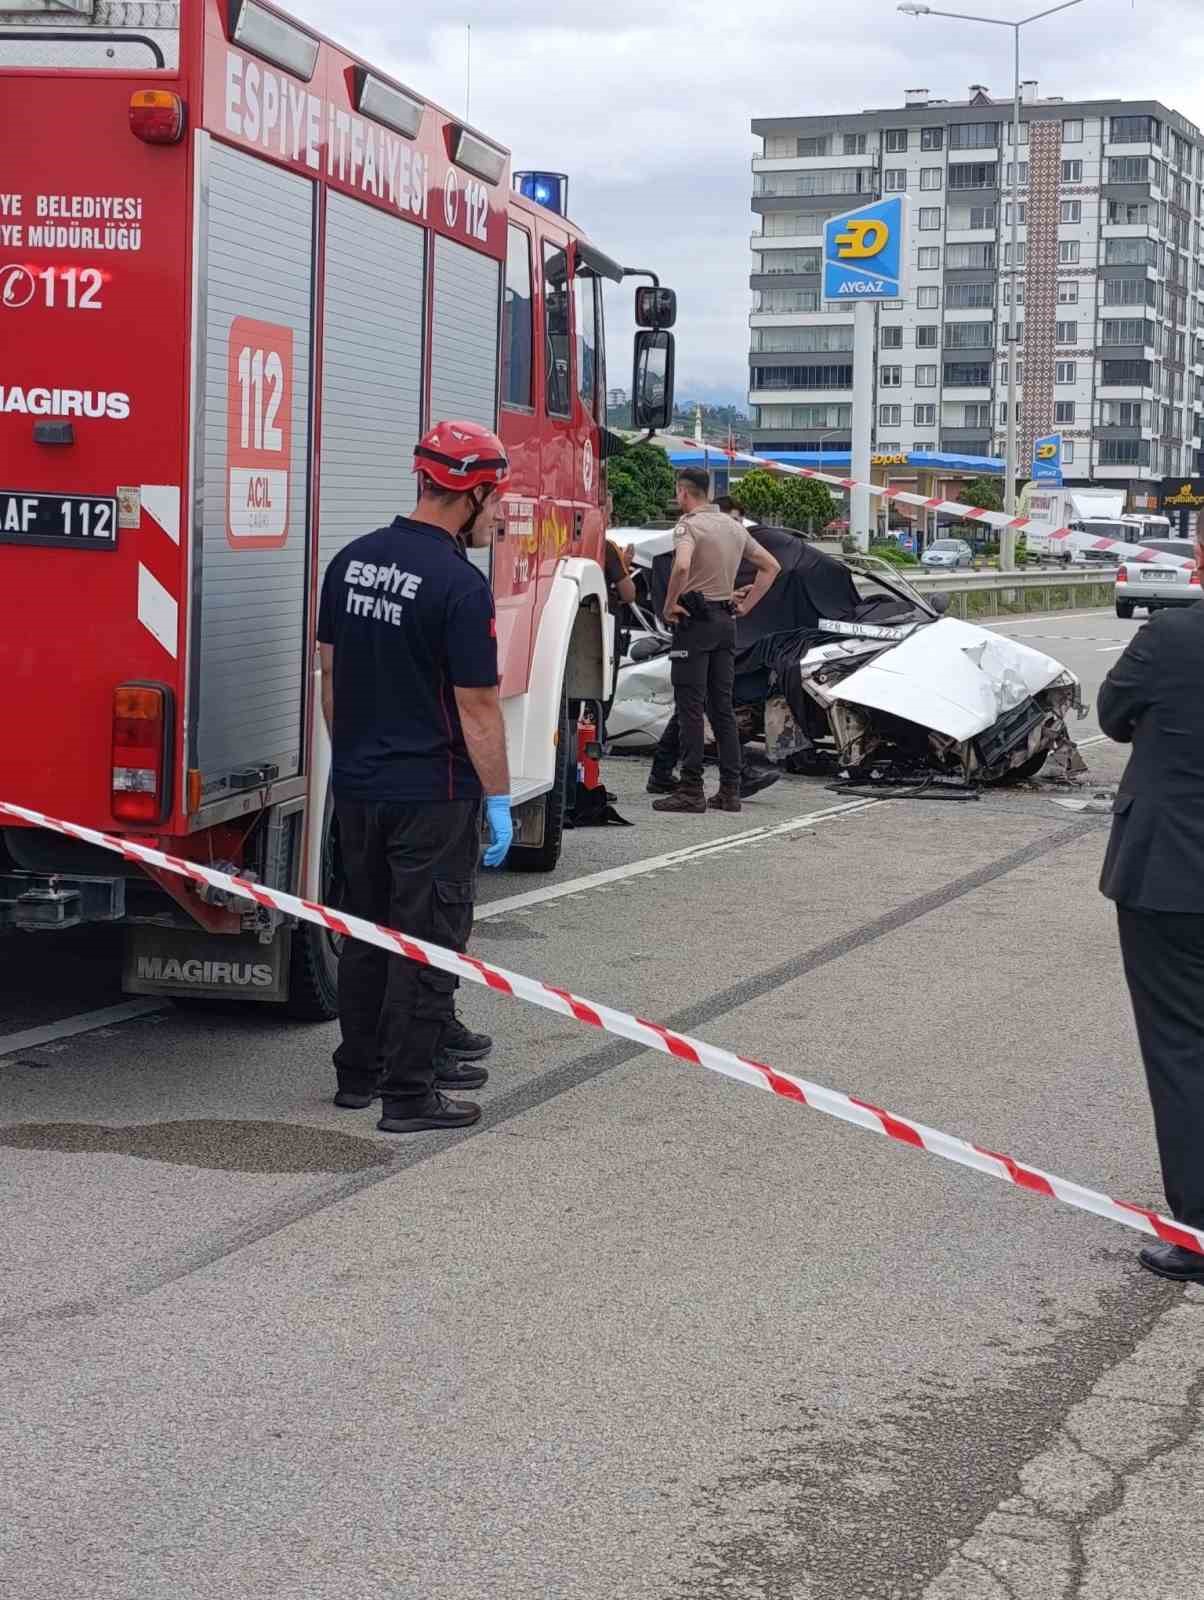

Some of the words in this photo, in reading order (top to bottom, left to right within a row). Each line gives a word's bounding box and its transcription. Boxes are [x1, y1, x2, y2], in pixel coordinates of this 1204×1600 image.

[464, 179, 489, 242] 112
[28, 220, 142, 251] MÜDÜRLÜĞÜ
[39, 266, 103, 309] 112
[838, 281, 885, 293] AYGAZ
[238, 346, 284, 452] 112
[0, 497, 39, 532] AF
[61, 501, 112, 538] 112
[343, 560, 423, 600] ESPİYE
[136, 956, 273, 986] MAGIRUS
